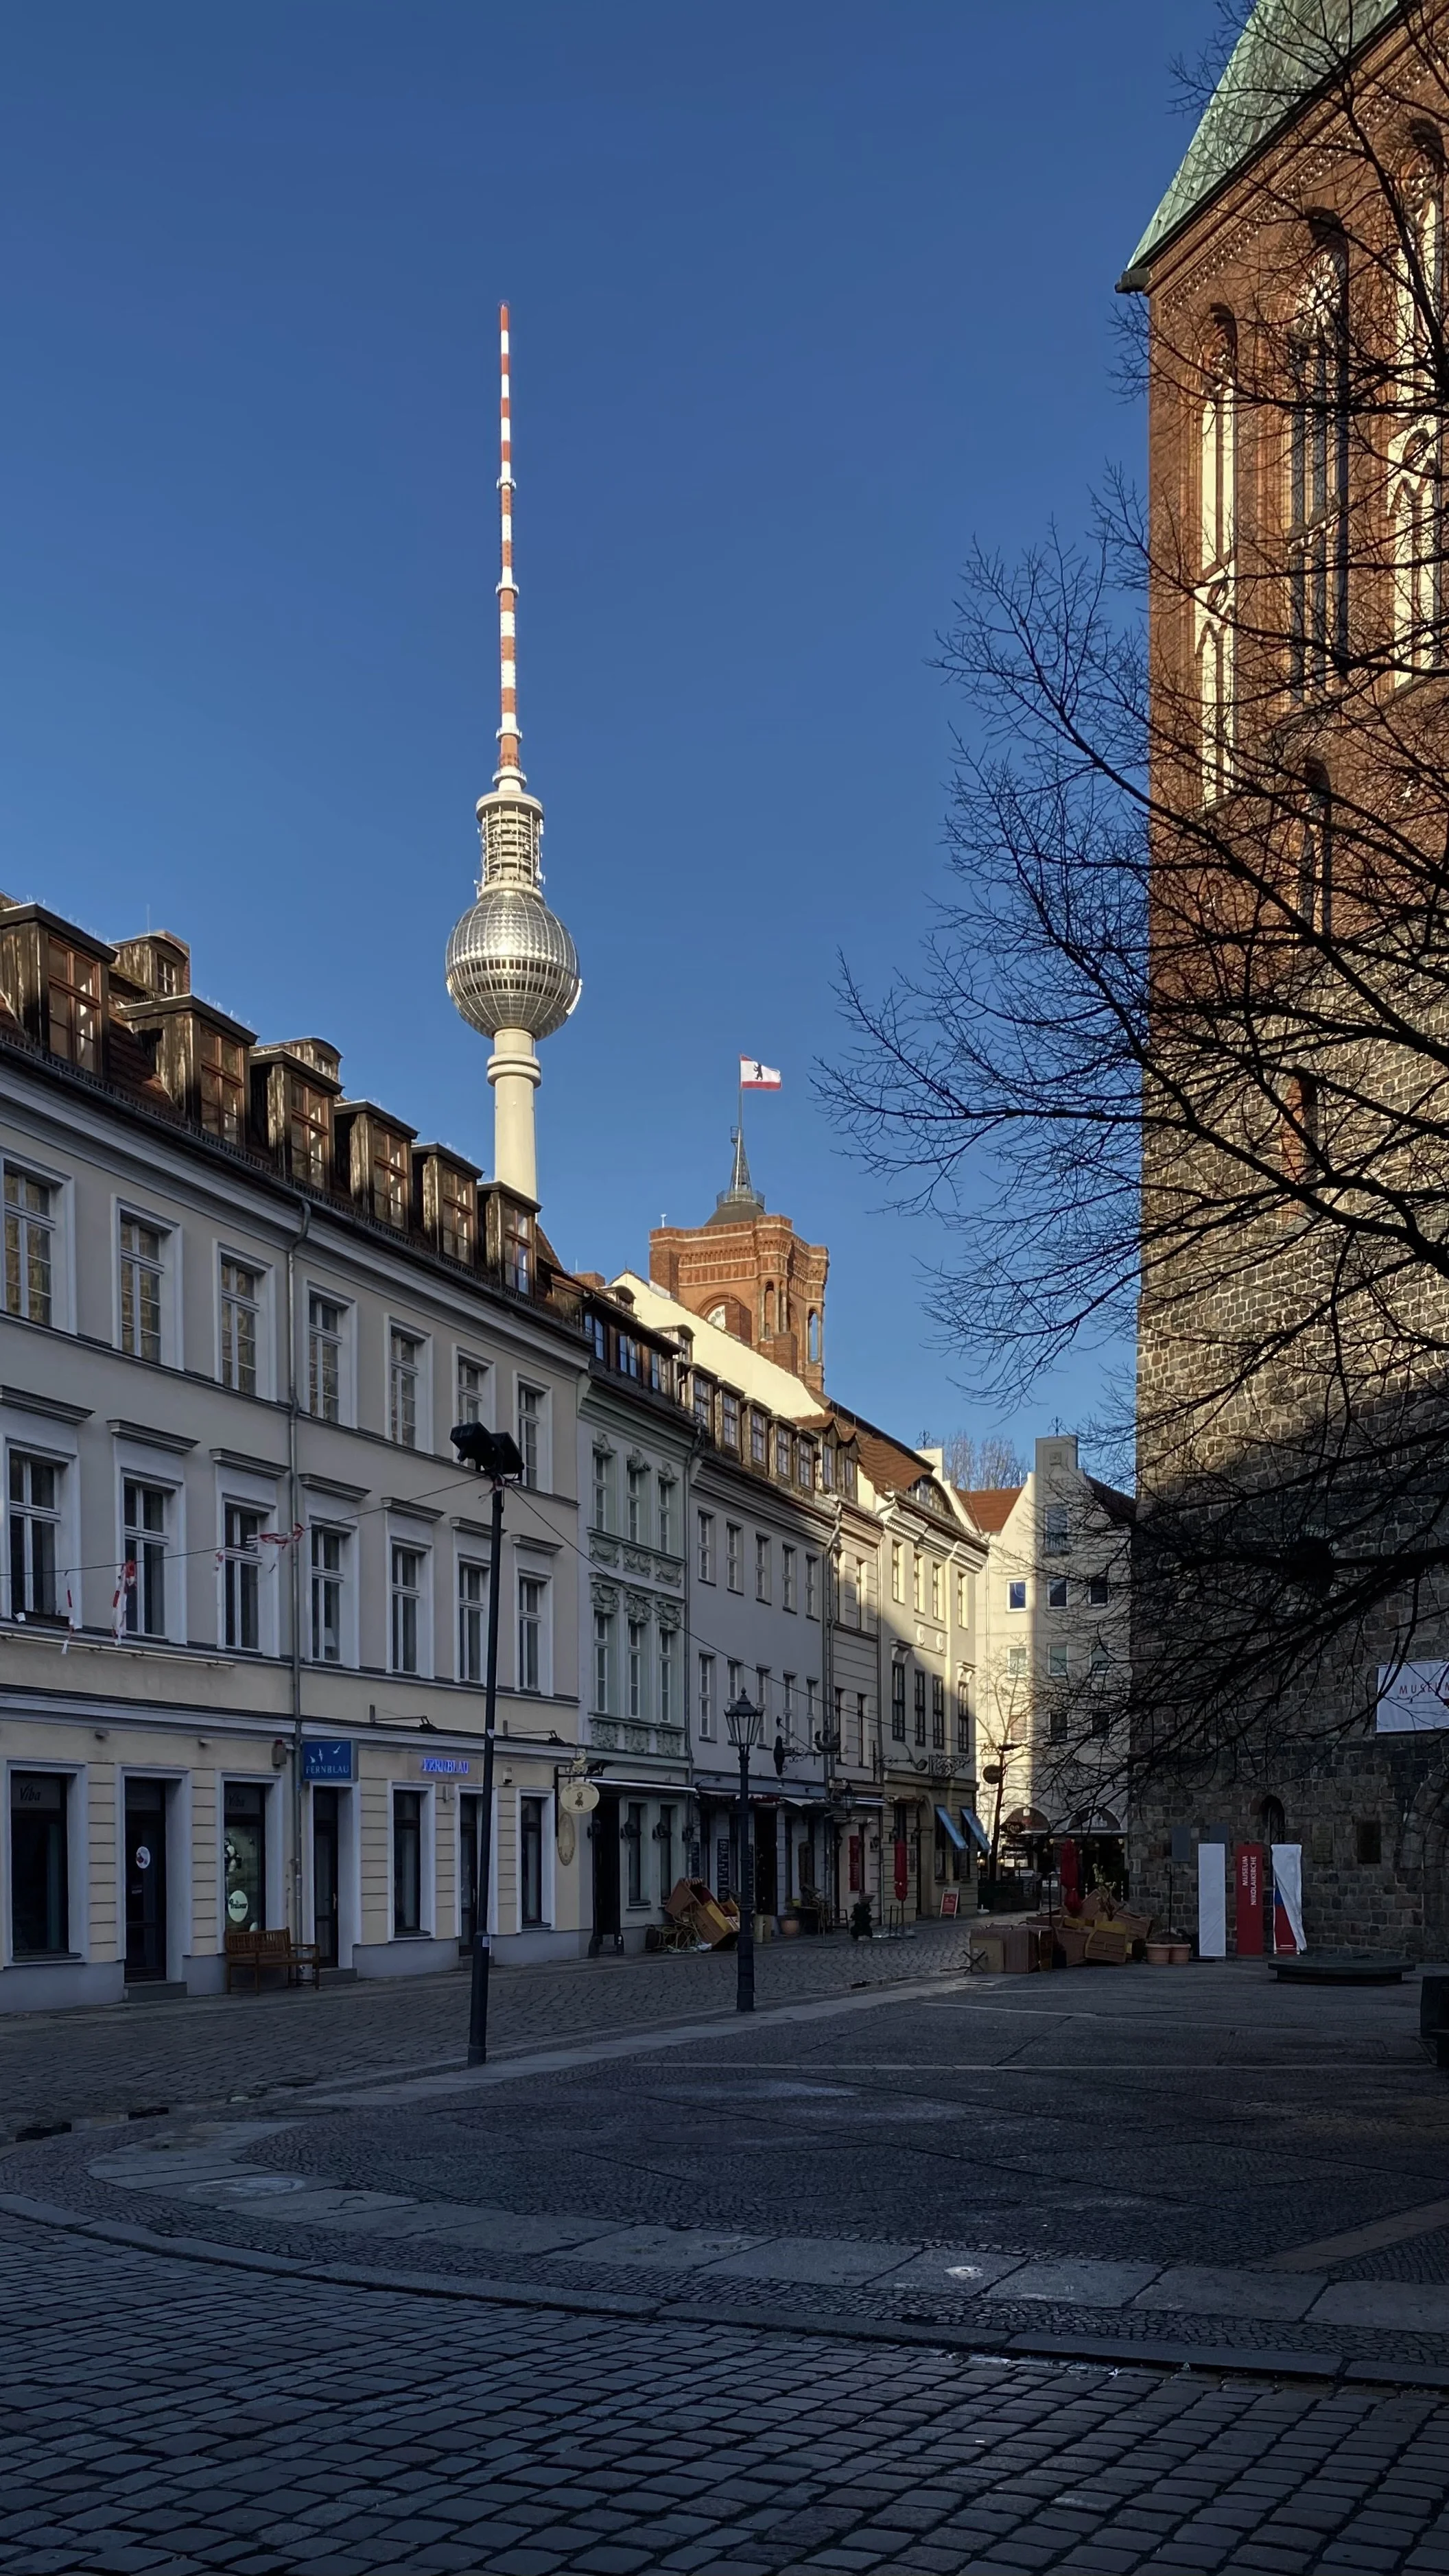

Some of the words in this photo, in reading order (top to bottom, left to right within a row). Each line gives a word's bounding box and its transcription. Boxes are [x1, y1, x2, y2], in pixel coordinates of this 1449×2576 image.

[305, 1764, 349, 1774] FERNBLAU
[422, 1758, 469, 1774] FERNBLAU
[20, 1782, 41, 1801] Viba
